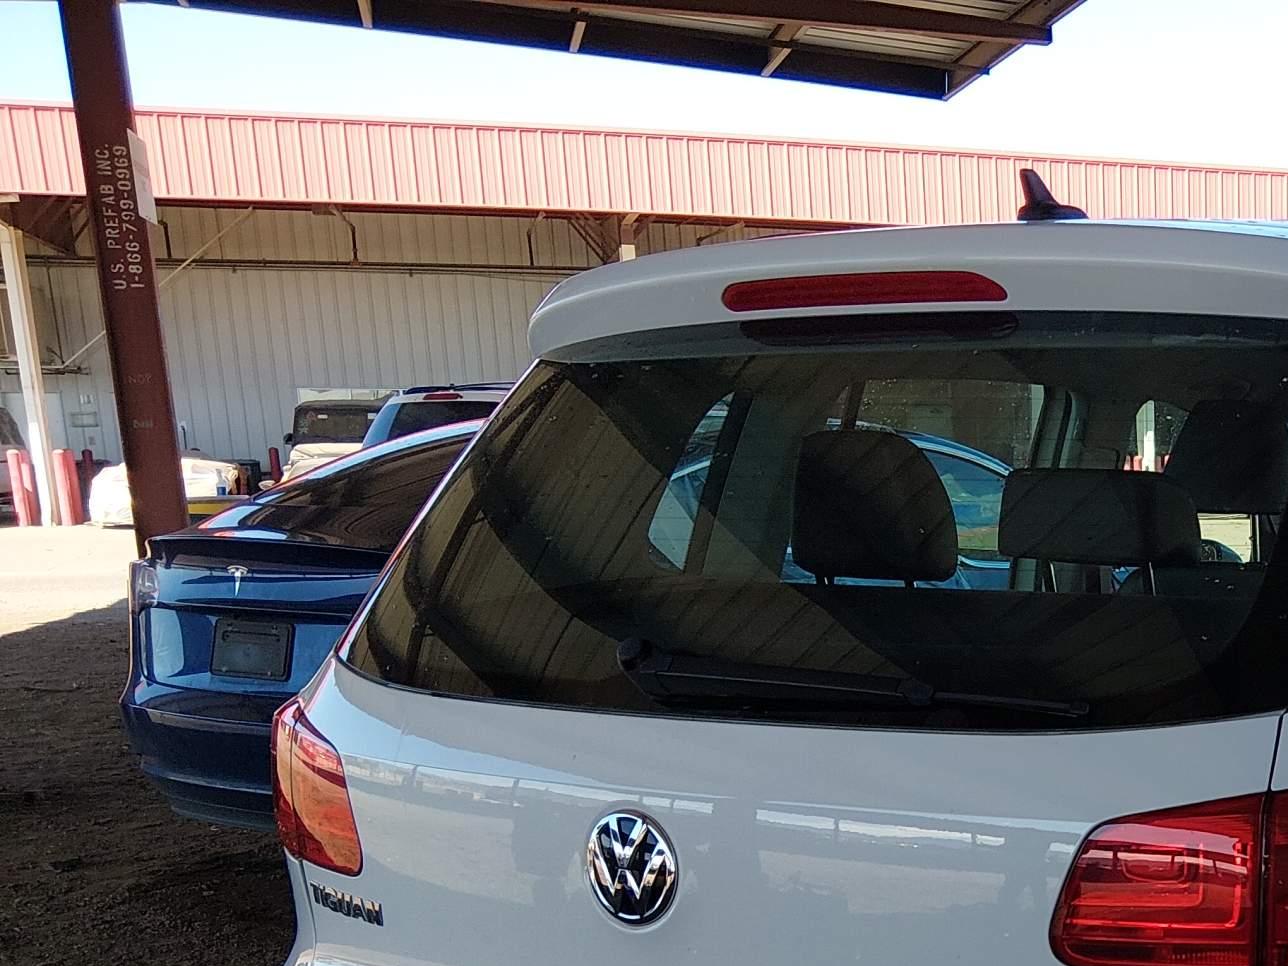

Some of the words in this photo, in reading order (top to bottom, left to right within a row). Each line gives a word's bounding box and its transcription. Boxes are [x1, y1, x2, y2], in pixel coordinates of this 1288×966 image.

[95, 143, 113, 175] INC.
[100, 184, 122, 249] PREFAB
[113, 145, 145, 288] 1-866-799-0969
[111, 258, 127, 290] U.S.
